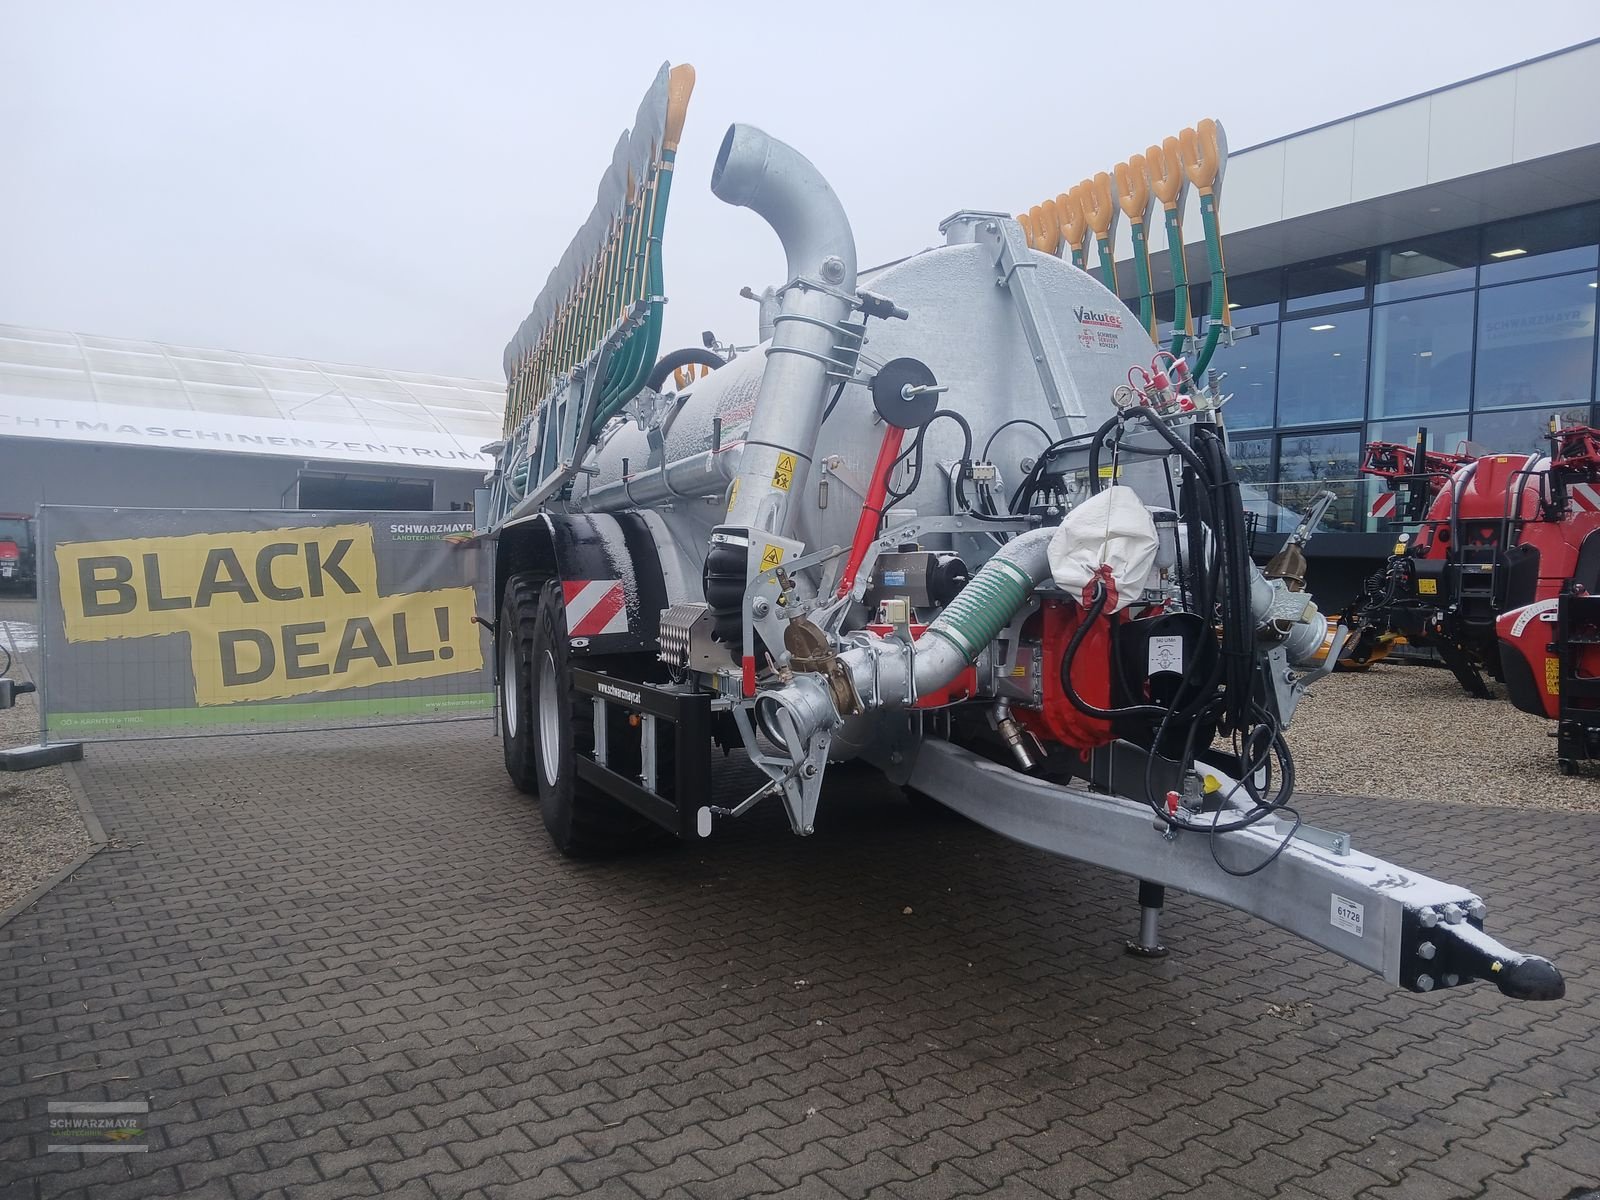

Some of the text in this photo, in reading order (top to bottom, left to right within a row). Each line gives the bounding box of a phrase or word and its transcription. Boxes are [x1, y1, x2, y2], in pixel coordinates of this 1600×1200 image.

[1073, 306, 1122, 324] Vakutec
[390, 523, 473, 533] SCHWARZMAYR
[77, 539, 361, 618] BLACK
[217, 606, 454, 687] DEAL!
[1338, 906, 1360, 922] 61728
